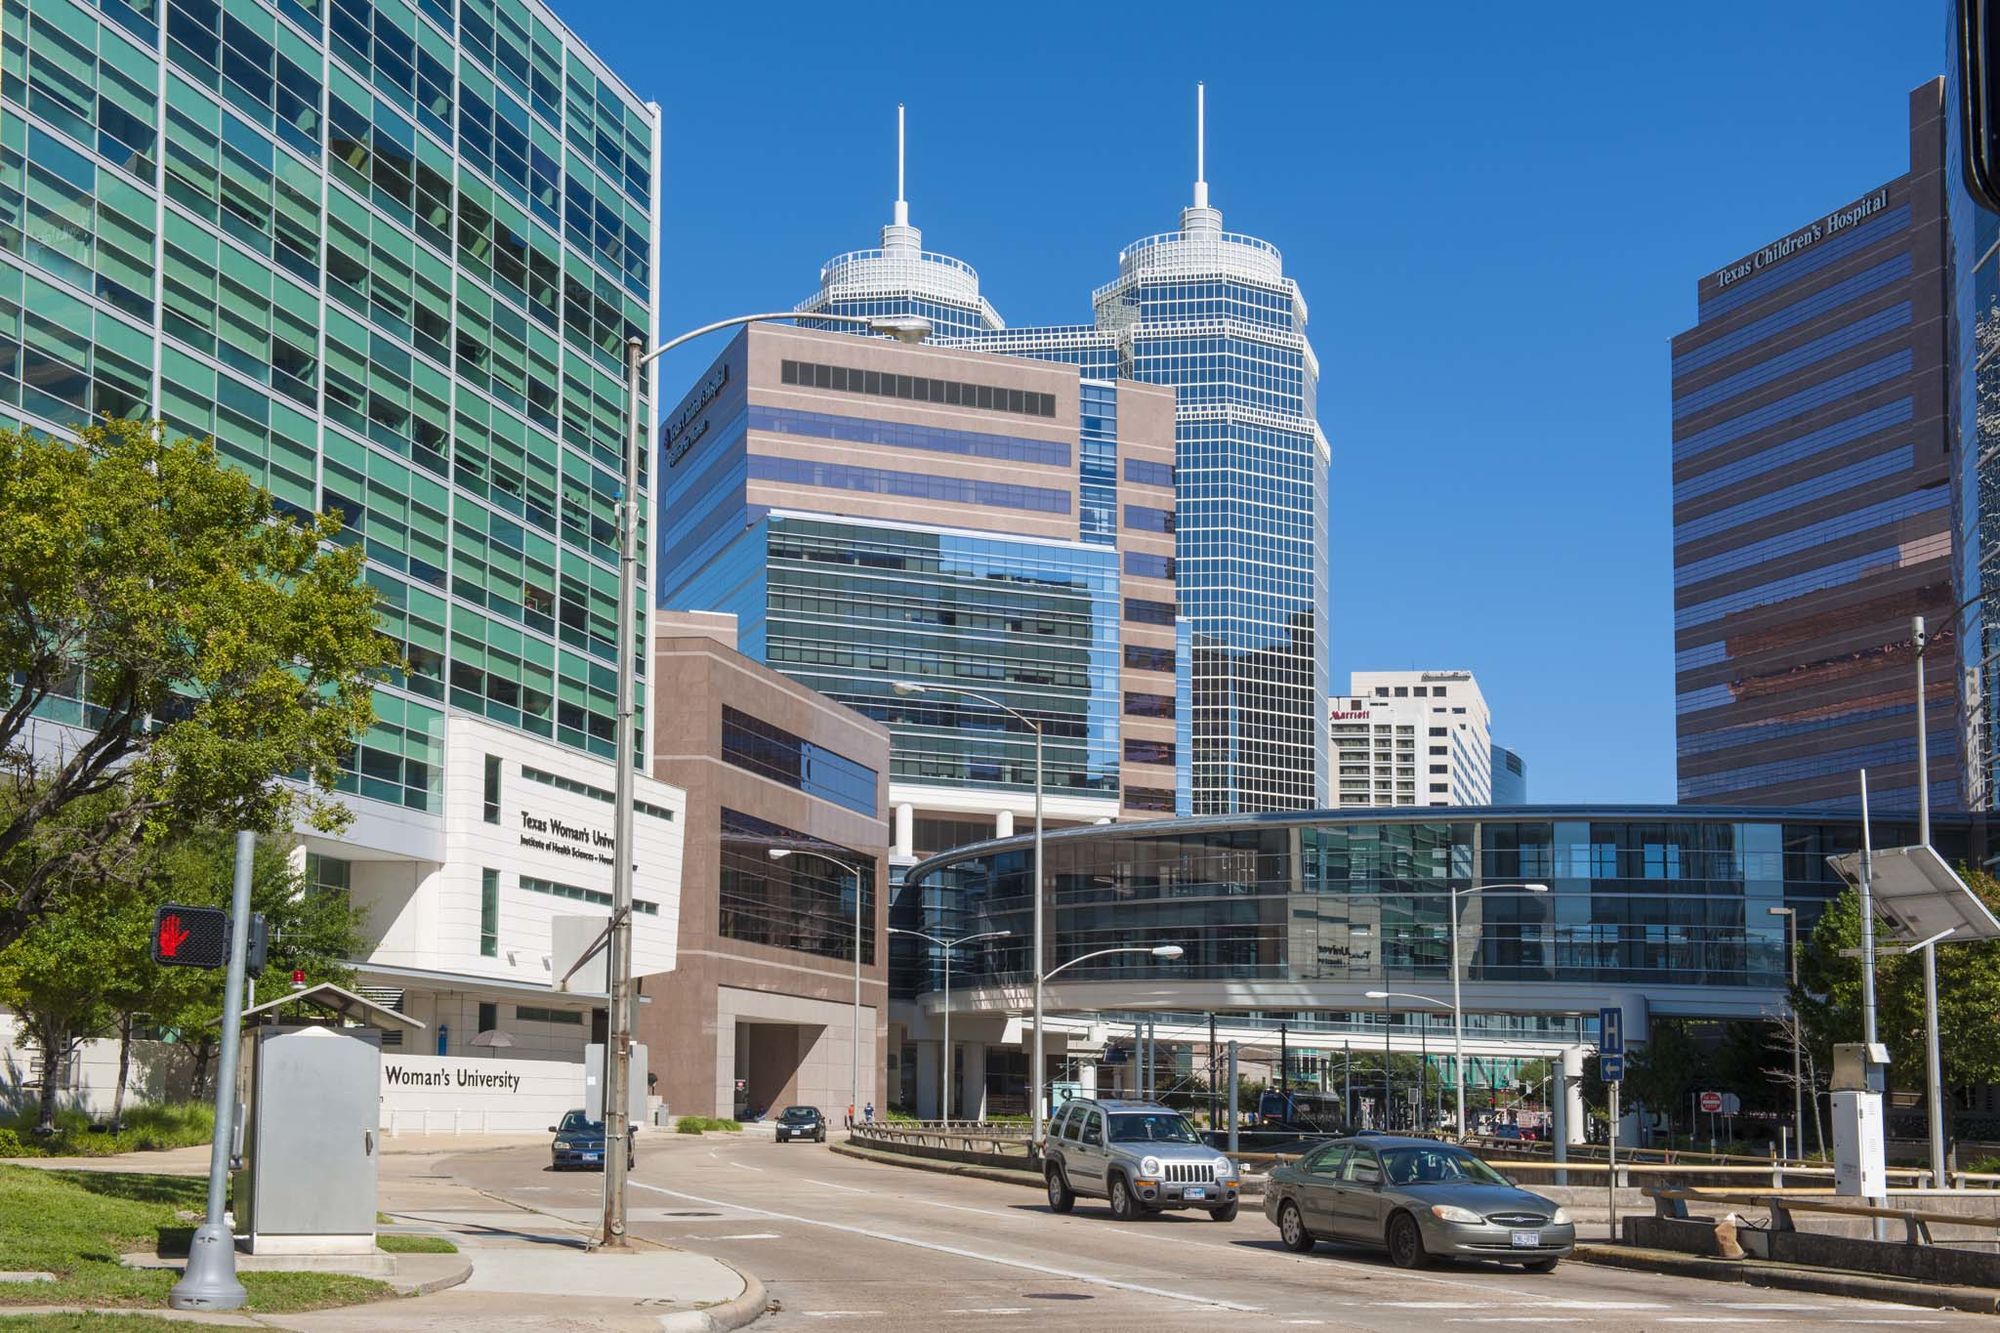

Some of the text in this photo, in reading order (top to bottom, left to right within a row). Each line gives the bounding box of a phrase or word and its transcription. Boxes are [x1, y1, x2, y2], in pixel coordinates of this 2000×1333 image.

[1716, 189, 1889, 288] Texas Children's Hospital
[1330, 710, 1370, 720] Marriott
[521, 810, 547, 833] Texas
[550, 818, 590, 844] Woman's
[1604, 1013, 1618, 1049] H
[385, 1065, 520, 1093] Woman's University
